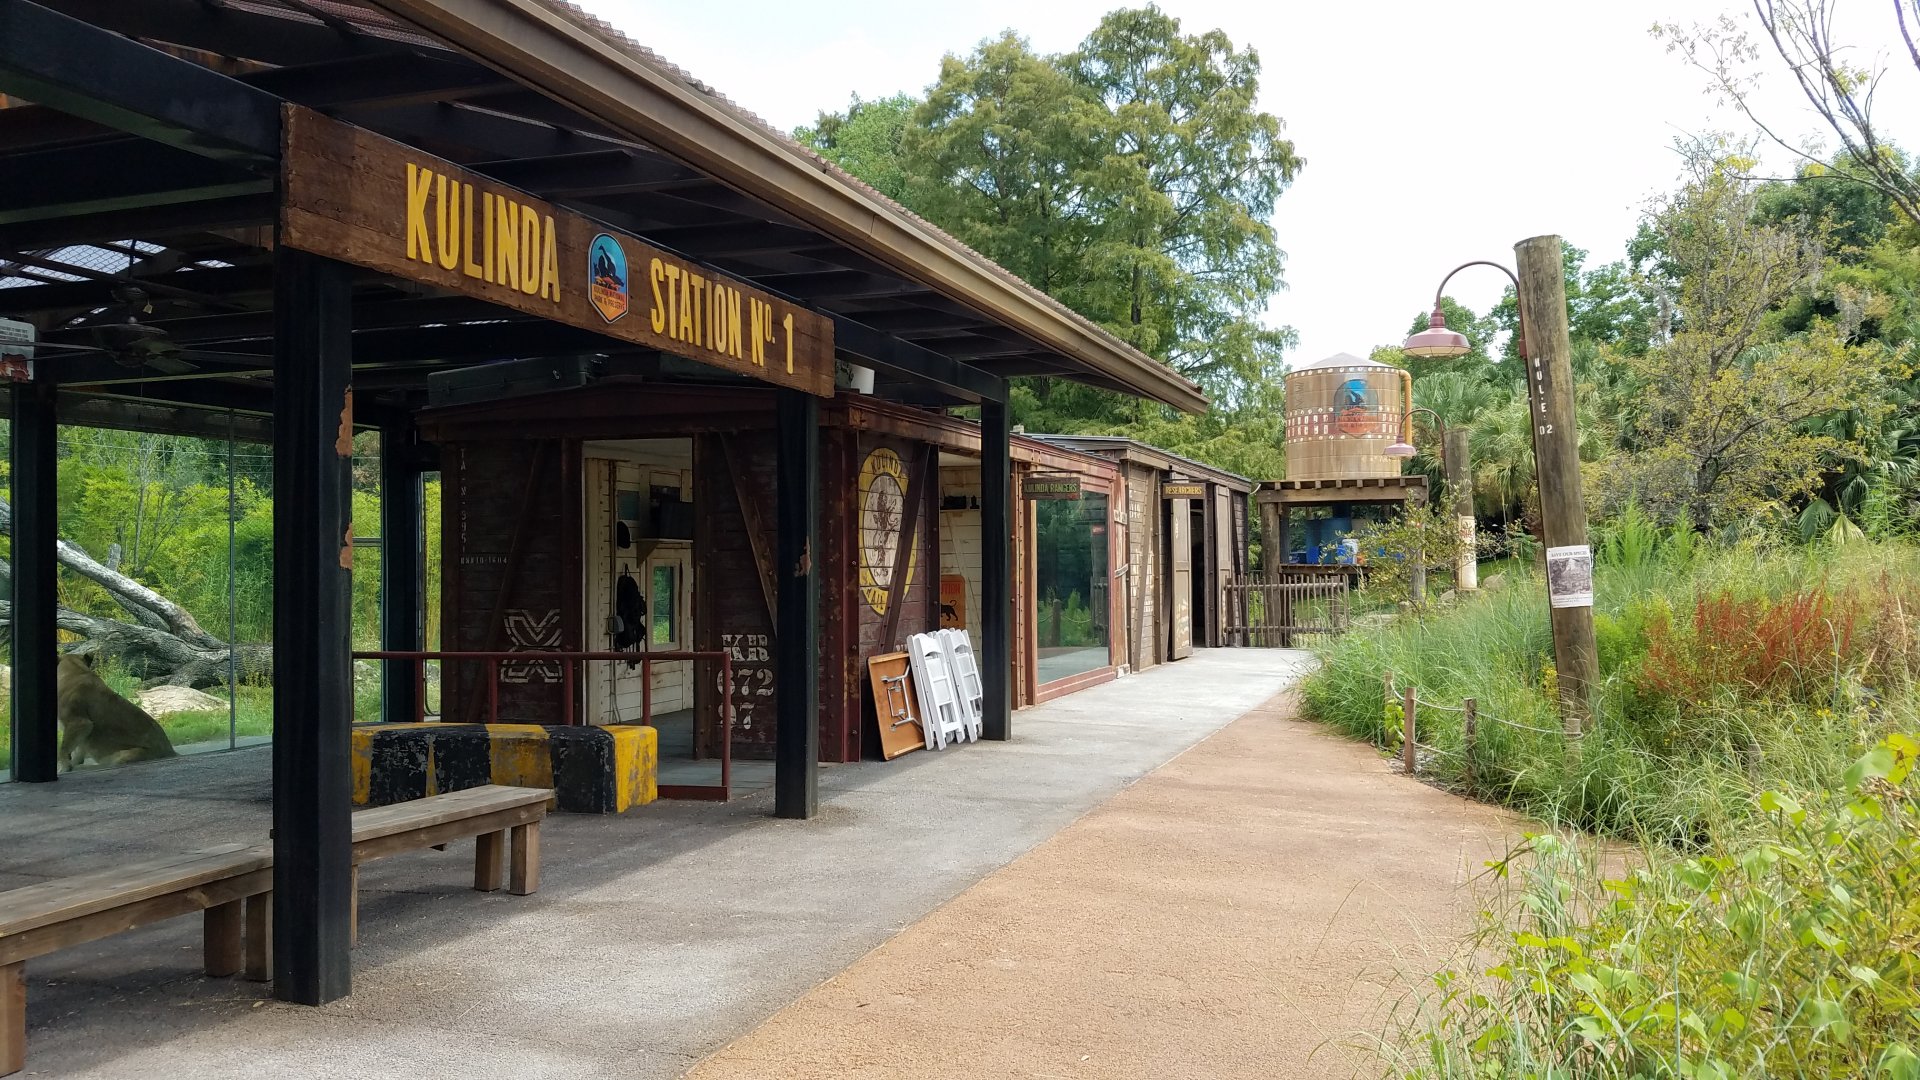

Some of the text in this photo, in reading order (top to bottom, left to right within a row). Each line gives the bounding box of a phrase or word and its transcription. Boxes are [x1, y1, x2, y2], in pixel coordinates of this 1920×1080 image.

[406, 162, 560, 303] KULINDA
[650, 257, 742, 359] STATION
[783, 312, 794, 375] 1
[1050, 482, 1078, 494] RANGERS
[1165, 485, 1203, 496] RESEARCHERS
[721, 634, 771, 662] KR
